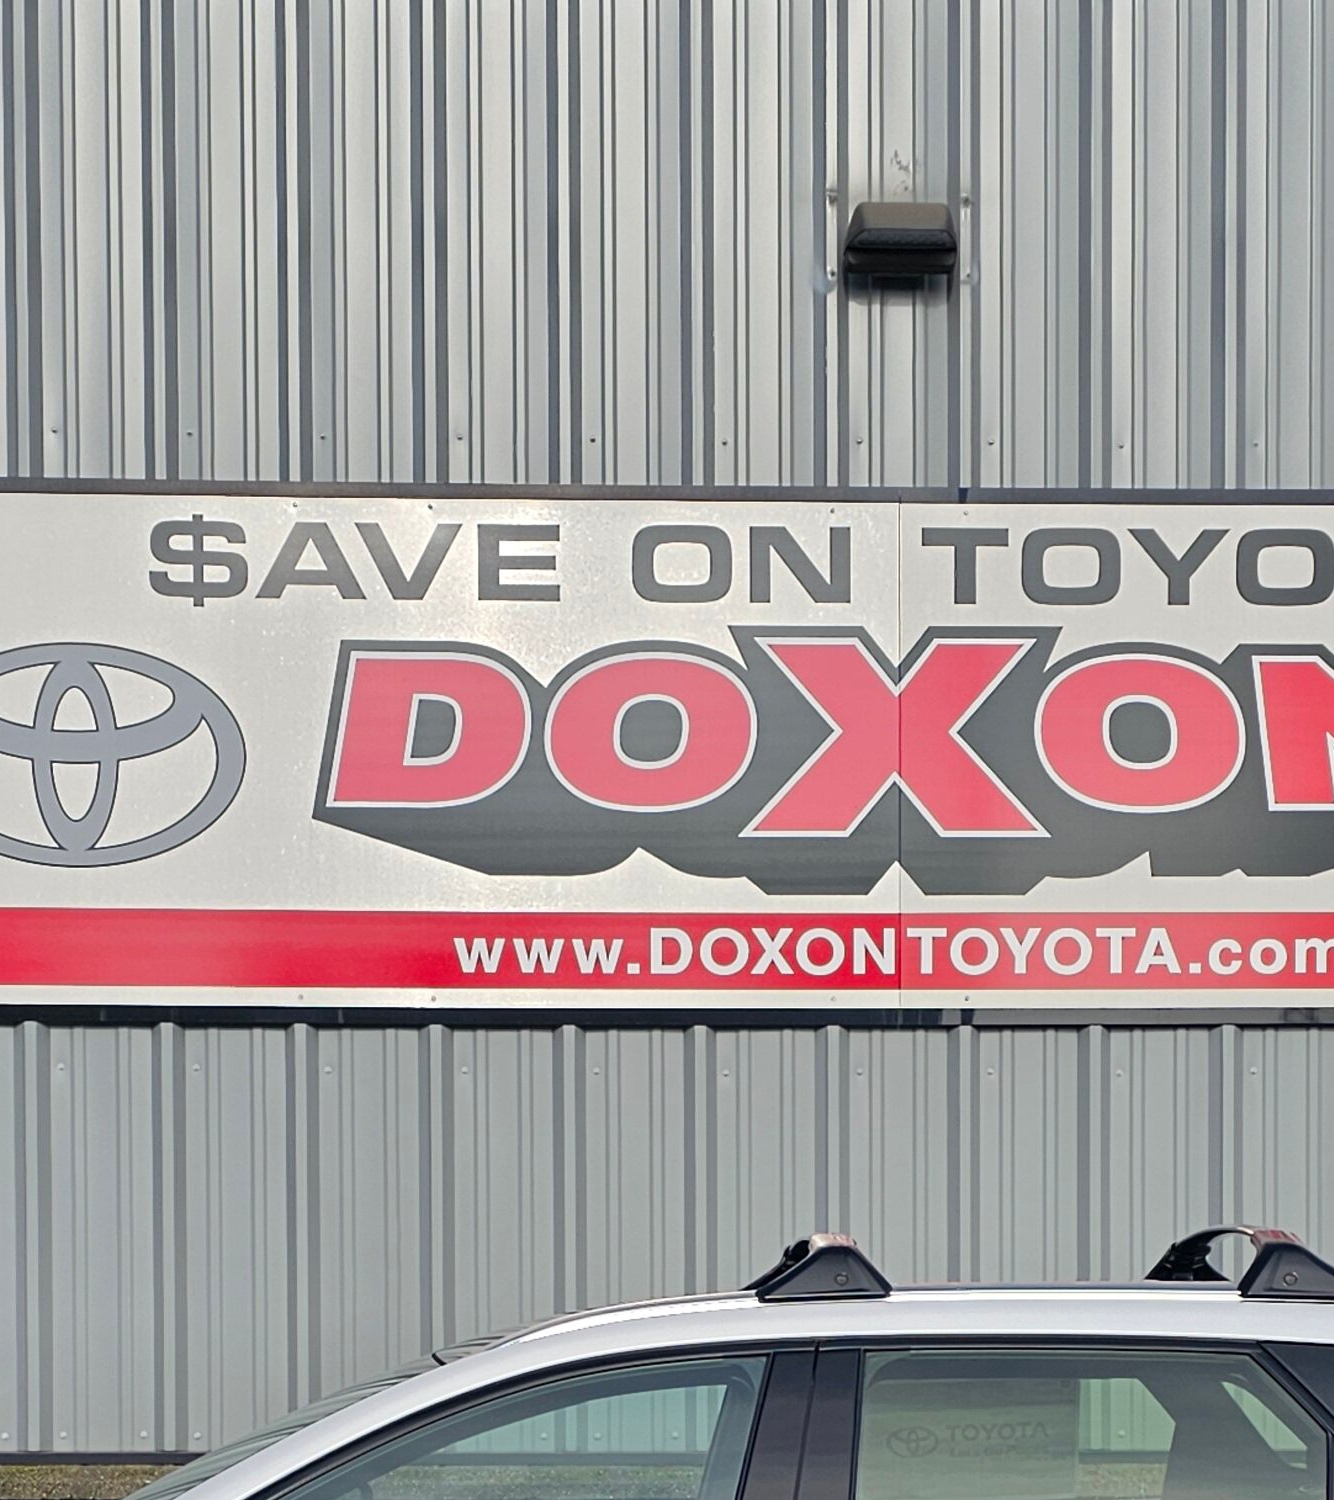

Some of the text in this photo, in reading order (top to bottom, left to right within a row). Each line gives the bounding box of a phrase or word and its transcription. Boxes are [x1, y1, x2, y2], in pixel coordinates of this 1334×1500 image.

[148, 514, 562, 608] $AVE
[631, 524, 852, 604] ON
[945, 1421, 1049, 1443] TOYOTA
